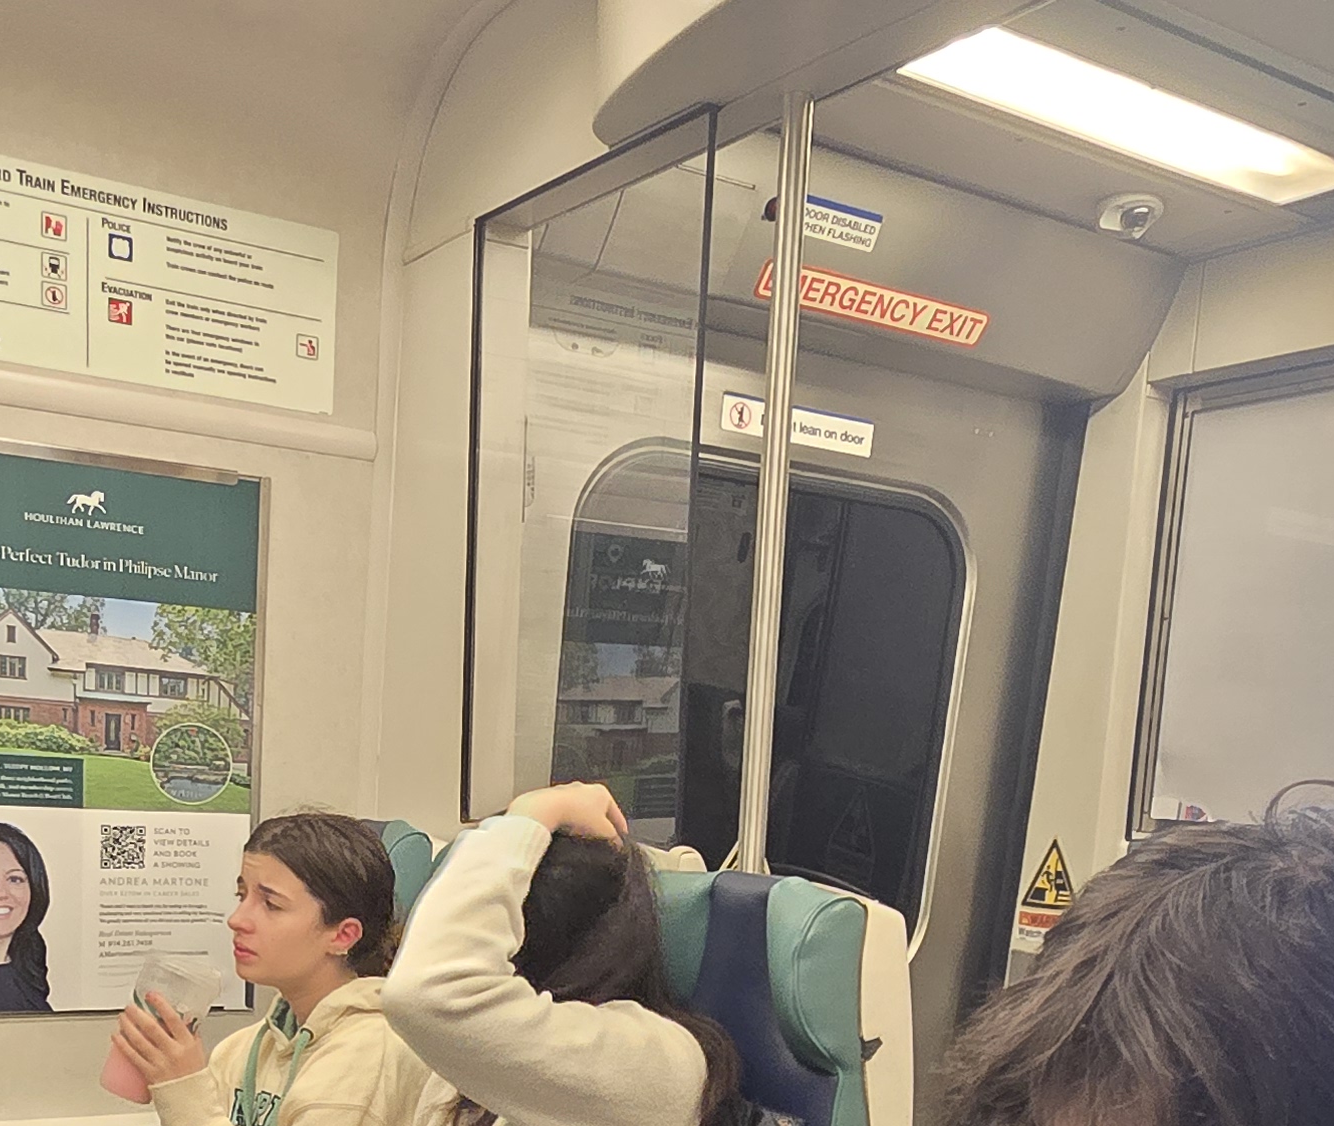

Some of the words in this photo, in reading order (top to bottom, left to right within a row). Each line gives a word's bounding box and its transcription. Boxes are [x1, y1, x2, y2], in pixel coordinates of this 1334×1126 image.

[17, 168, 55, 192] TRAIN
[61, 178, 137, 212] EMERGENCY
[141, 198, 228, 230] INSTRUCTIONS
[101, 217, 131, 235] POLICE
[831, 216, 876, 235] DISABLED
[827, 227, 872, 247] FLASHING
[101, 282, 153, 302] EVACUATION
[763, 270, 928, 326] ERGENCY
[926, 308, 983, 340] EXIT
[799, 422, 821, 437] lean
[824, 428, 837, 440] on
[840, 431, 865, 445] door
[24, 511, 84, 528] HOULIHAN
[86, 519, 145, 535] LAWRENCE
[56, 552, 101, 571] Tudor
[103, 557, 116, 572] in
[119, 557, 172, 579] Philipse
[174, 564, 218, 583] Manor
[100, 877, 148, 886] ANDREA
[153, 878, 209, 887] MARTONE
